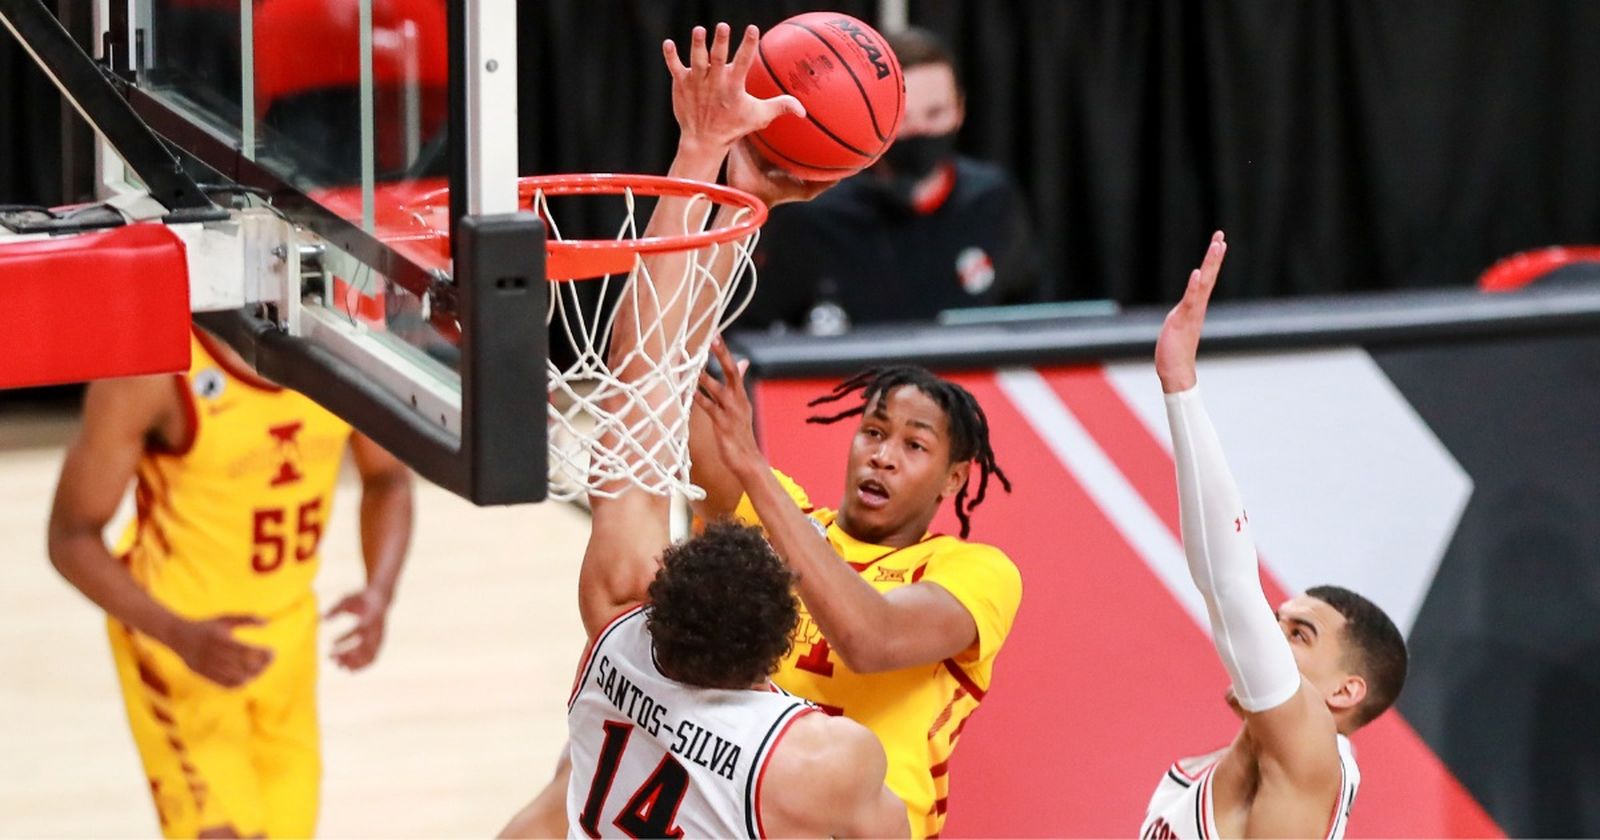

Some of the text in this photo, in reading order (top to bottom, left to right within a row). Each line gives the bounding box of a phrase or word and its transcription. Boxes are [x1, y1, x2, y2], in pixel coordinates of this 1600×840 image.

[831, 19, 890, 80] NCAA
[251, 497, 322, 574] 55
[596, 655, 742, 781] SANTOS-SILVA
[579, 719, 690, 840] 14
